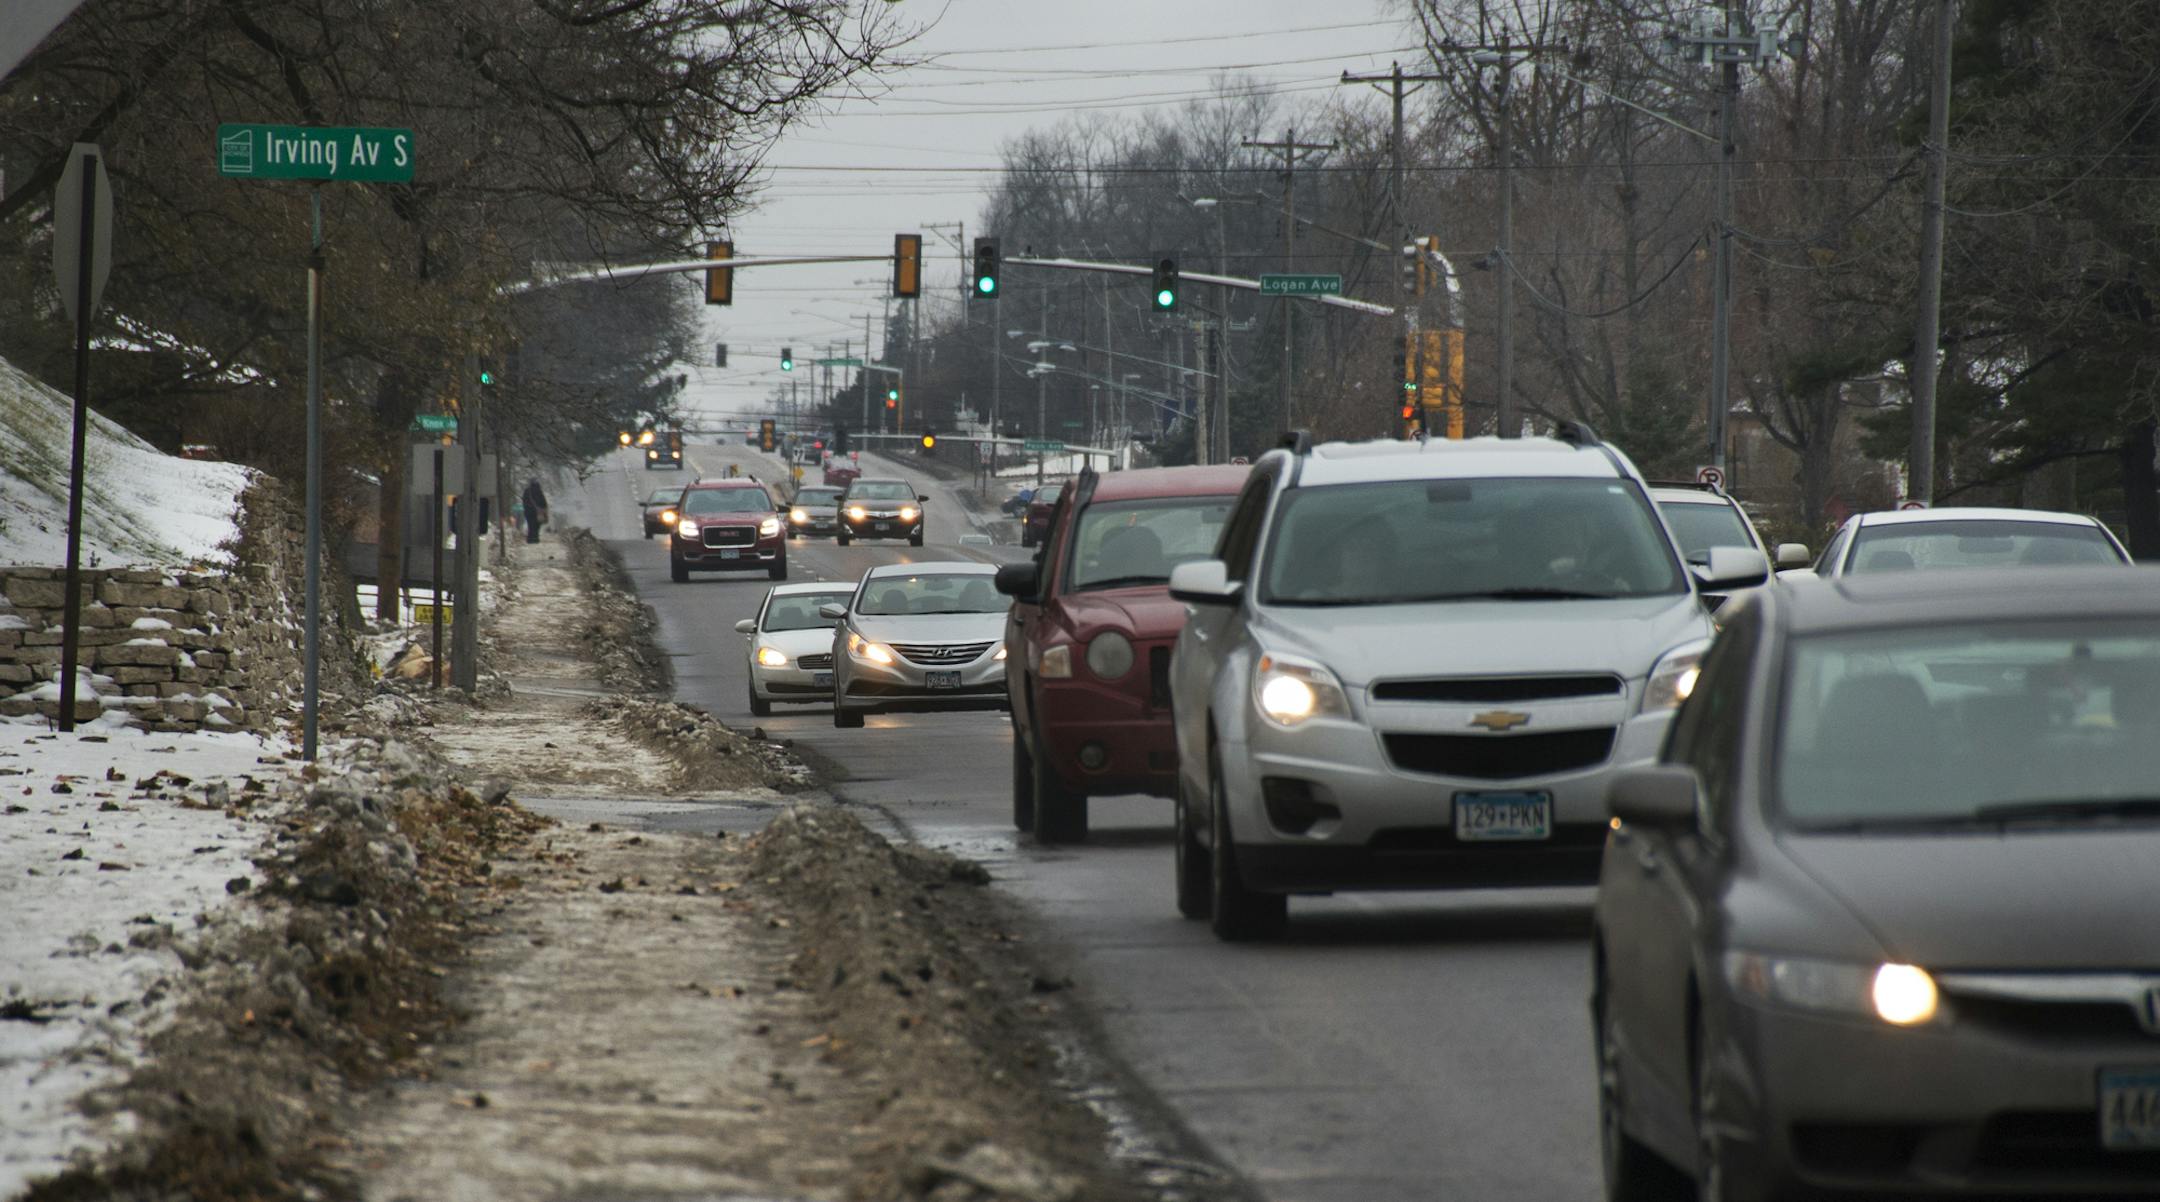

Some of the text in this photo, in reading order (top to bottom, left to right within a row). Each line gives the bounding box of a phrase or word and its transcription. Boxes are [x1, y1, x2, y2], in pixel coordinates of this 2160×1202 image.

[267, 131, 408, 175] Irving Av S
[1263, 279, 1338, 293] Logan Ave
[1462, 805, 1545, 829] 129 PKN
